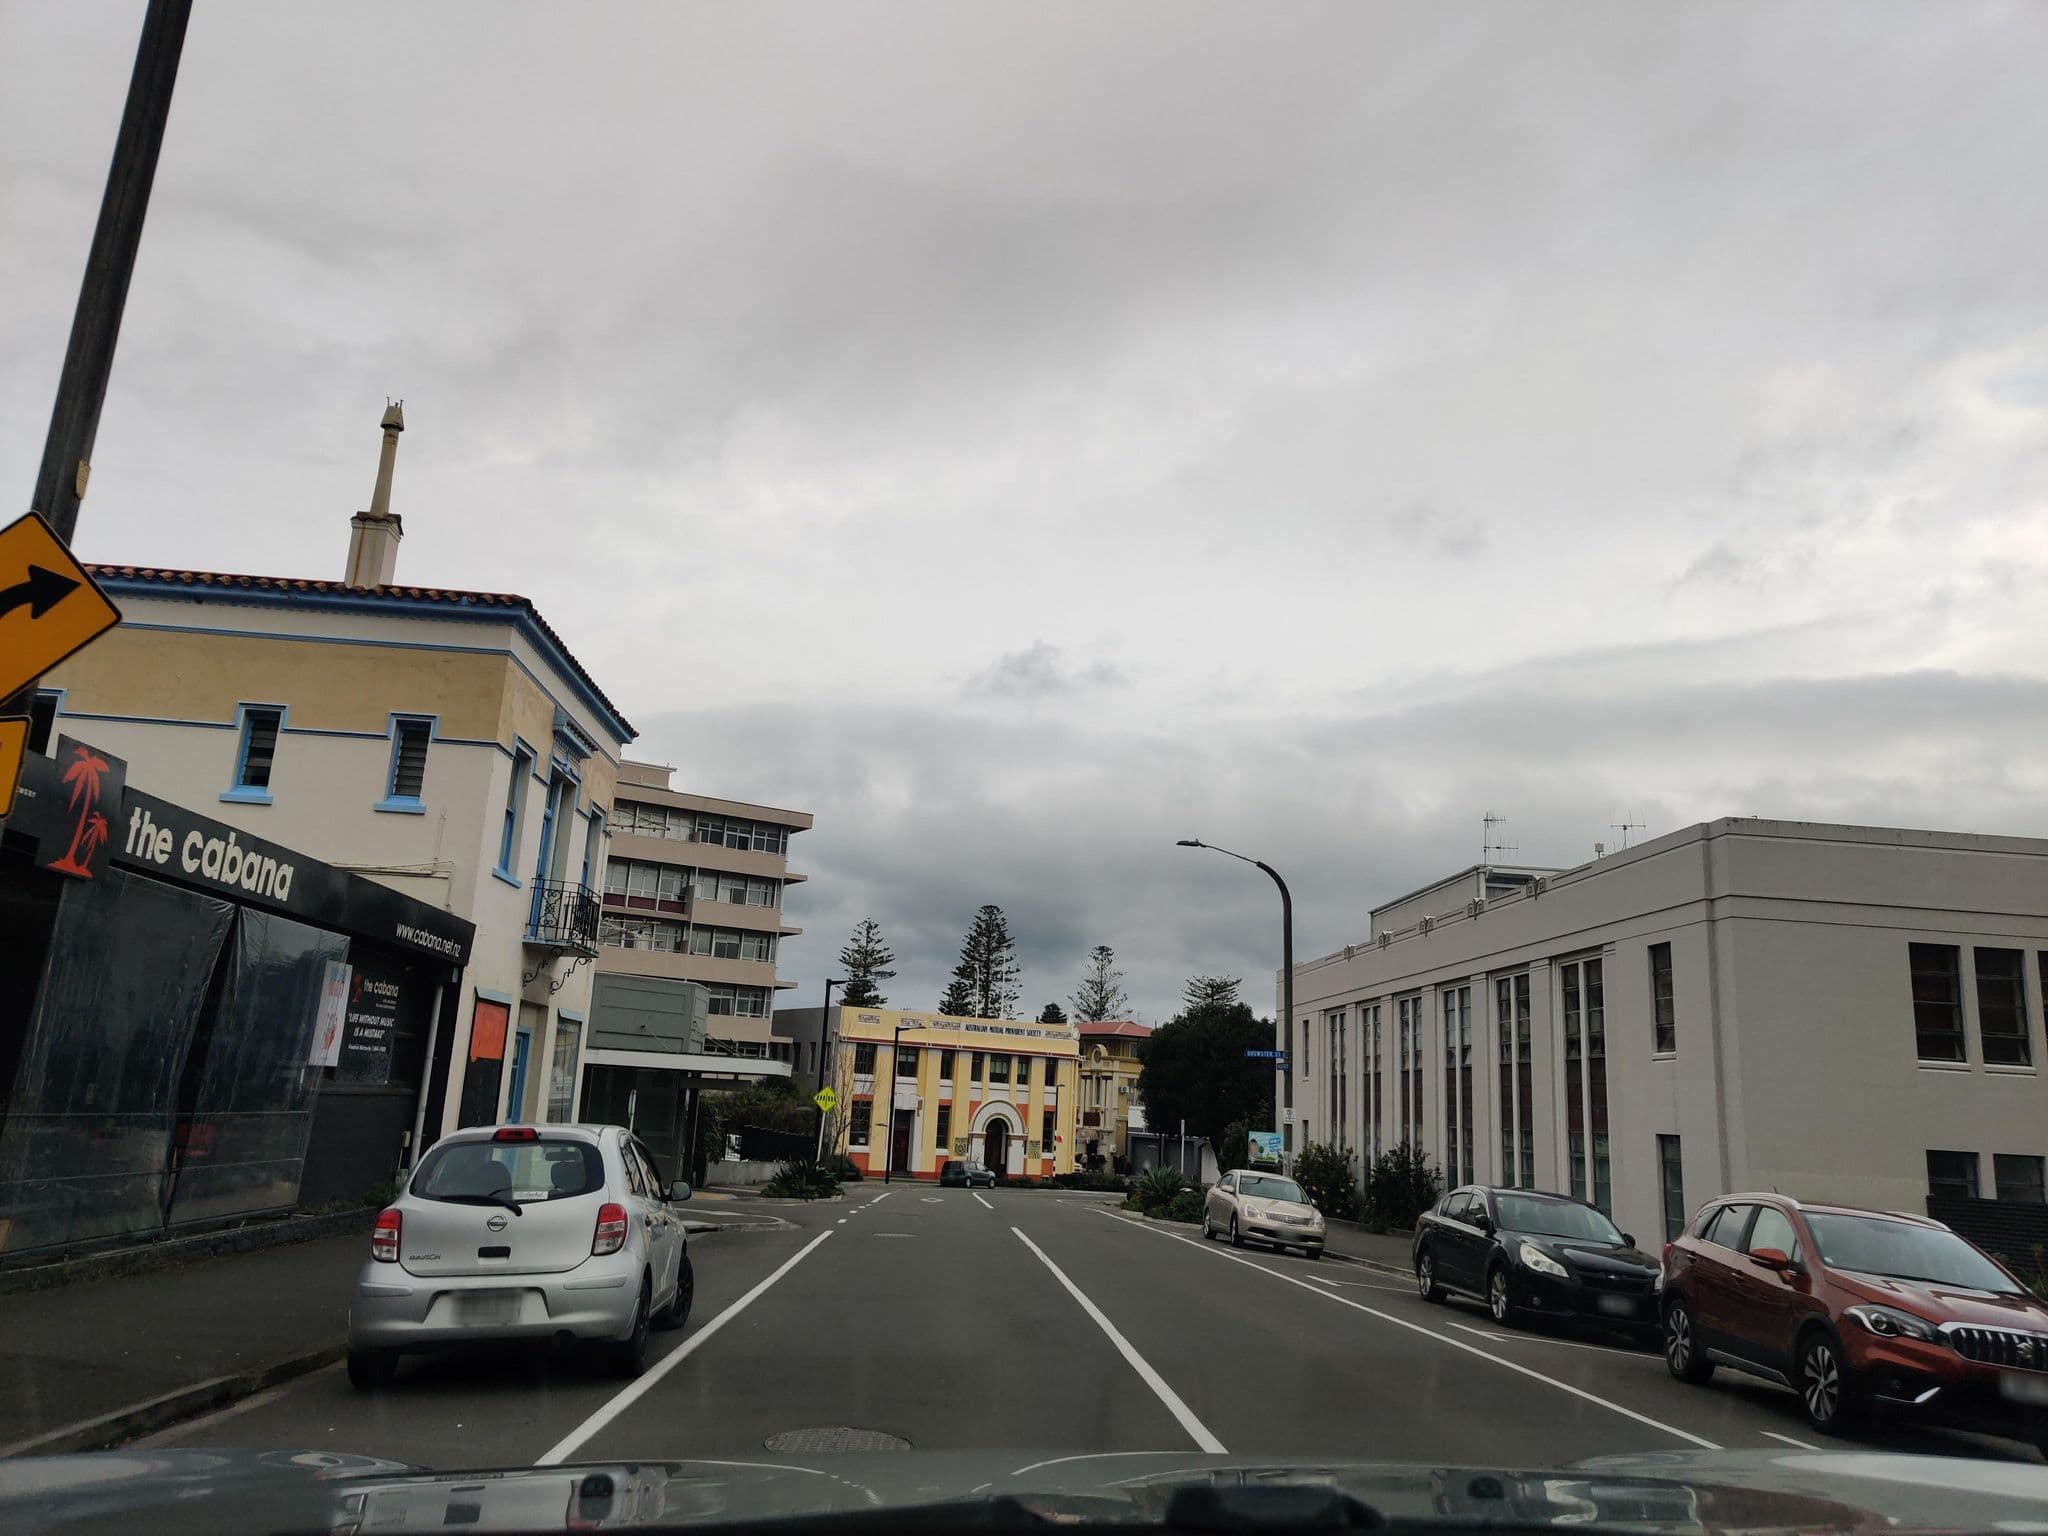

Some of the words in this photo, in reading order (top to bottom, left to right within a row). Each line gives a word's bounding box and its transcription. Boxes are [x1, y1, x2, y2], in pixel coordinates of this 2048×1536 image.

[125, 806, 173, 864] the
[181, 830, 294, 901] cabana
[396, 923, 461, 957] www.cabana.net.nz
[363, 979, 373, 993] the
[374, 980, 399, 998] cabana
[965, 1023, 988, 1033] AUSTRALIAN
[989, 1024, 1004, 1034] MUTUAL
[1004, 1026, 1026, 1036] PROVIDENT
[1026, 1029, 1041, 1038] SOCIETY
